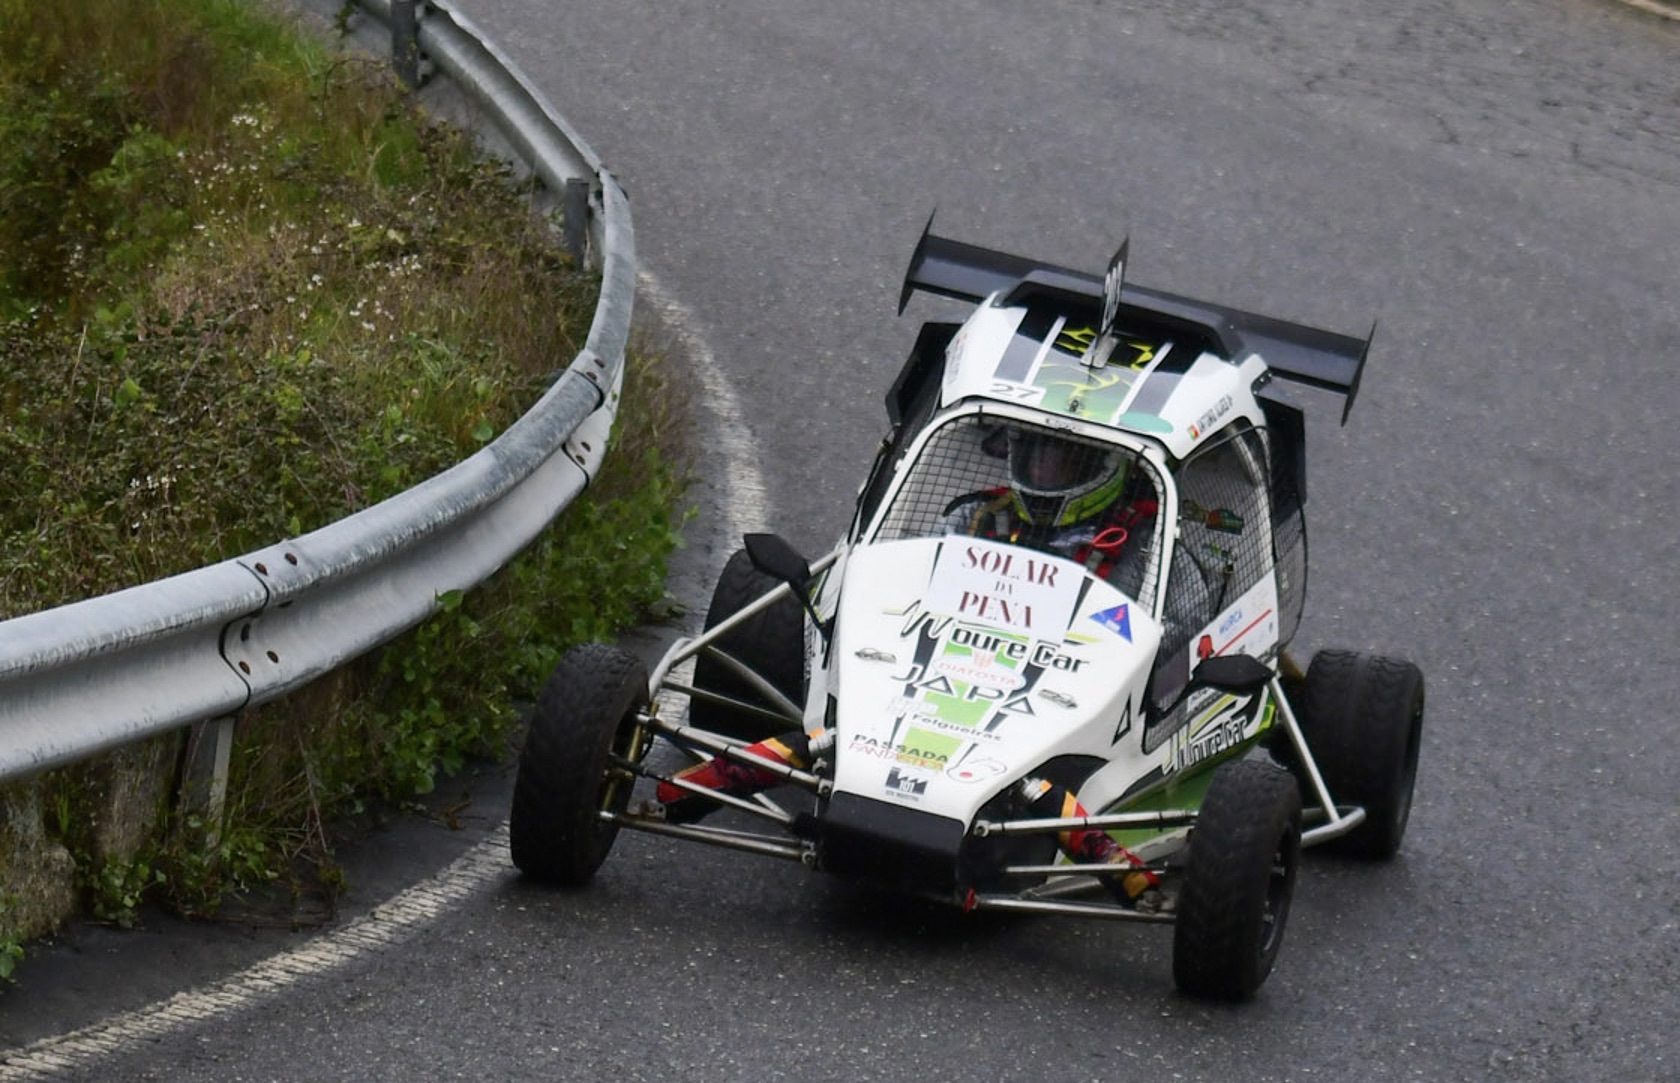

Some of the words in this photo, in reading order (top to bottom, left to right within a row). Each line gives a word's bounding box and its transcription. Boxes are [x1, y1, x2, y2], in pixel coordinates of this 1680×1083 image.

[990, 383, 1041, 398] 27
[961, 546, 1059, 588] SOLAR
[995, 580, 1014, 595] DA
[959, 591, 1032, 628] PENA
[890, 667, 1036, 716] JAPA
[912, 713, 1002, 741] Felgueiras
[853, 734, 949, 763] PASSADA
